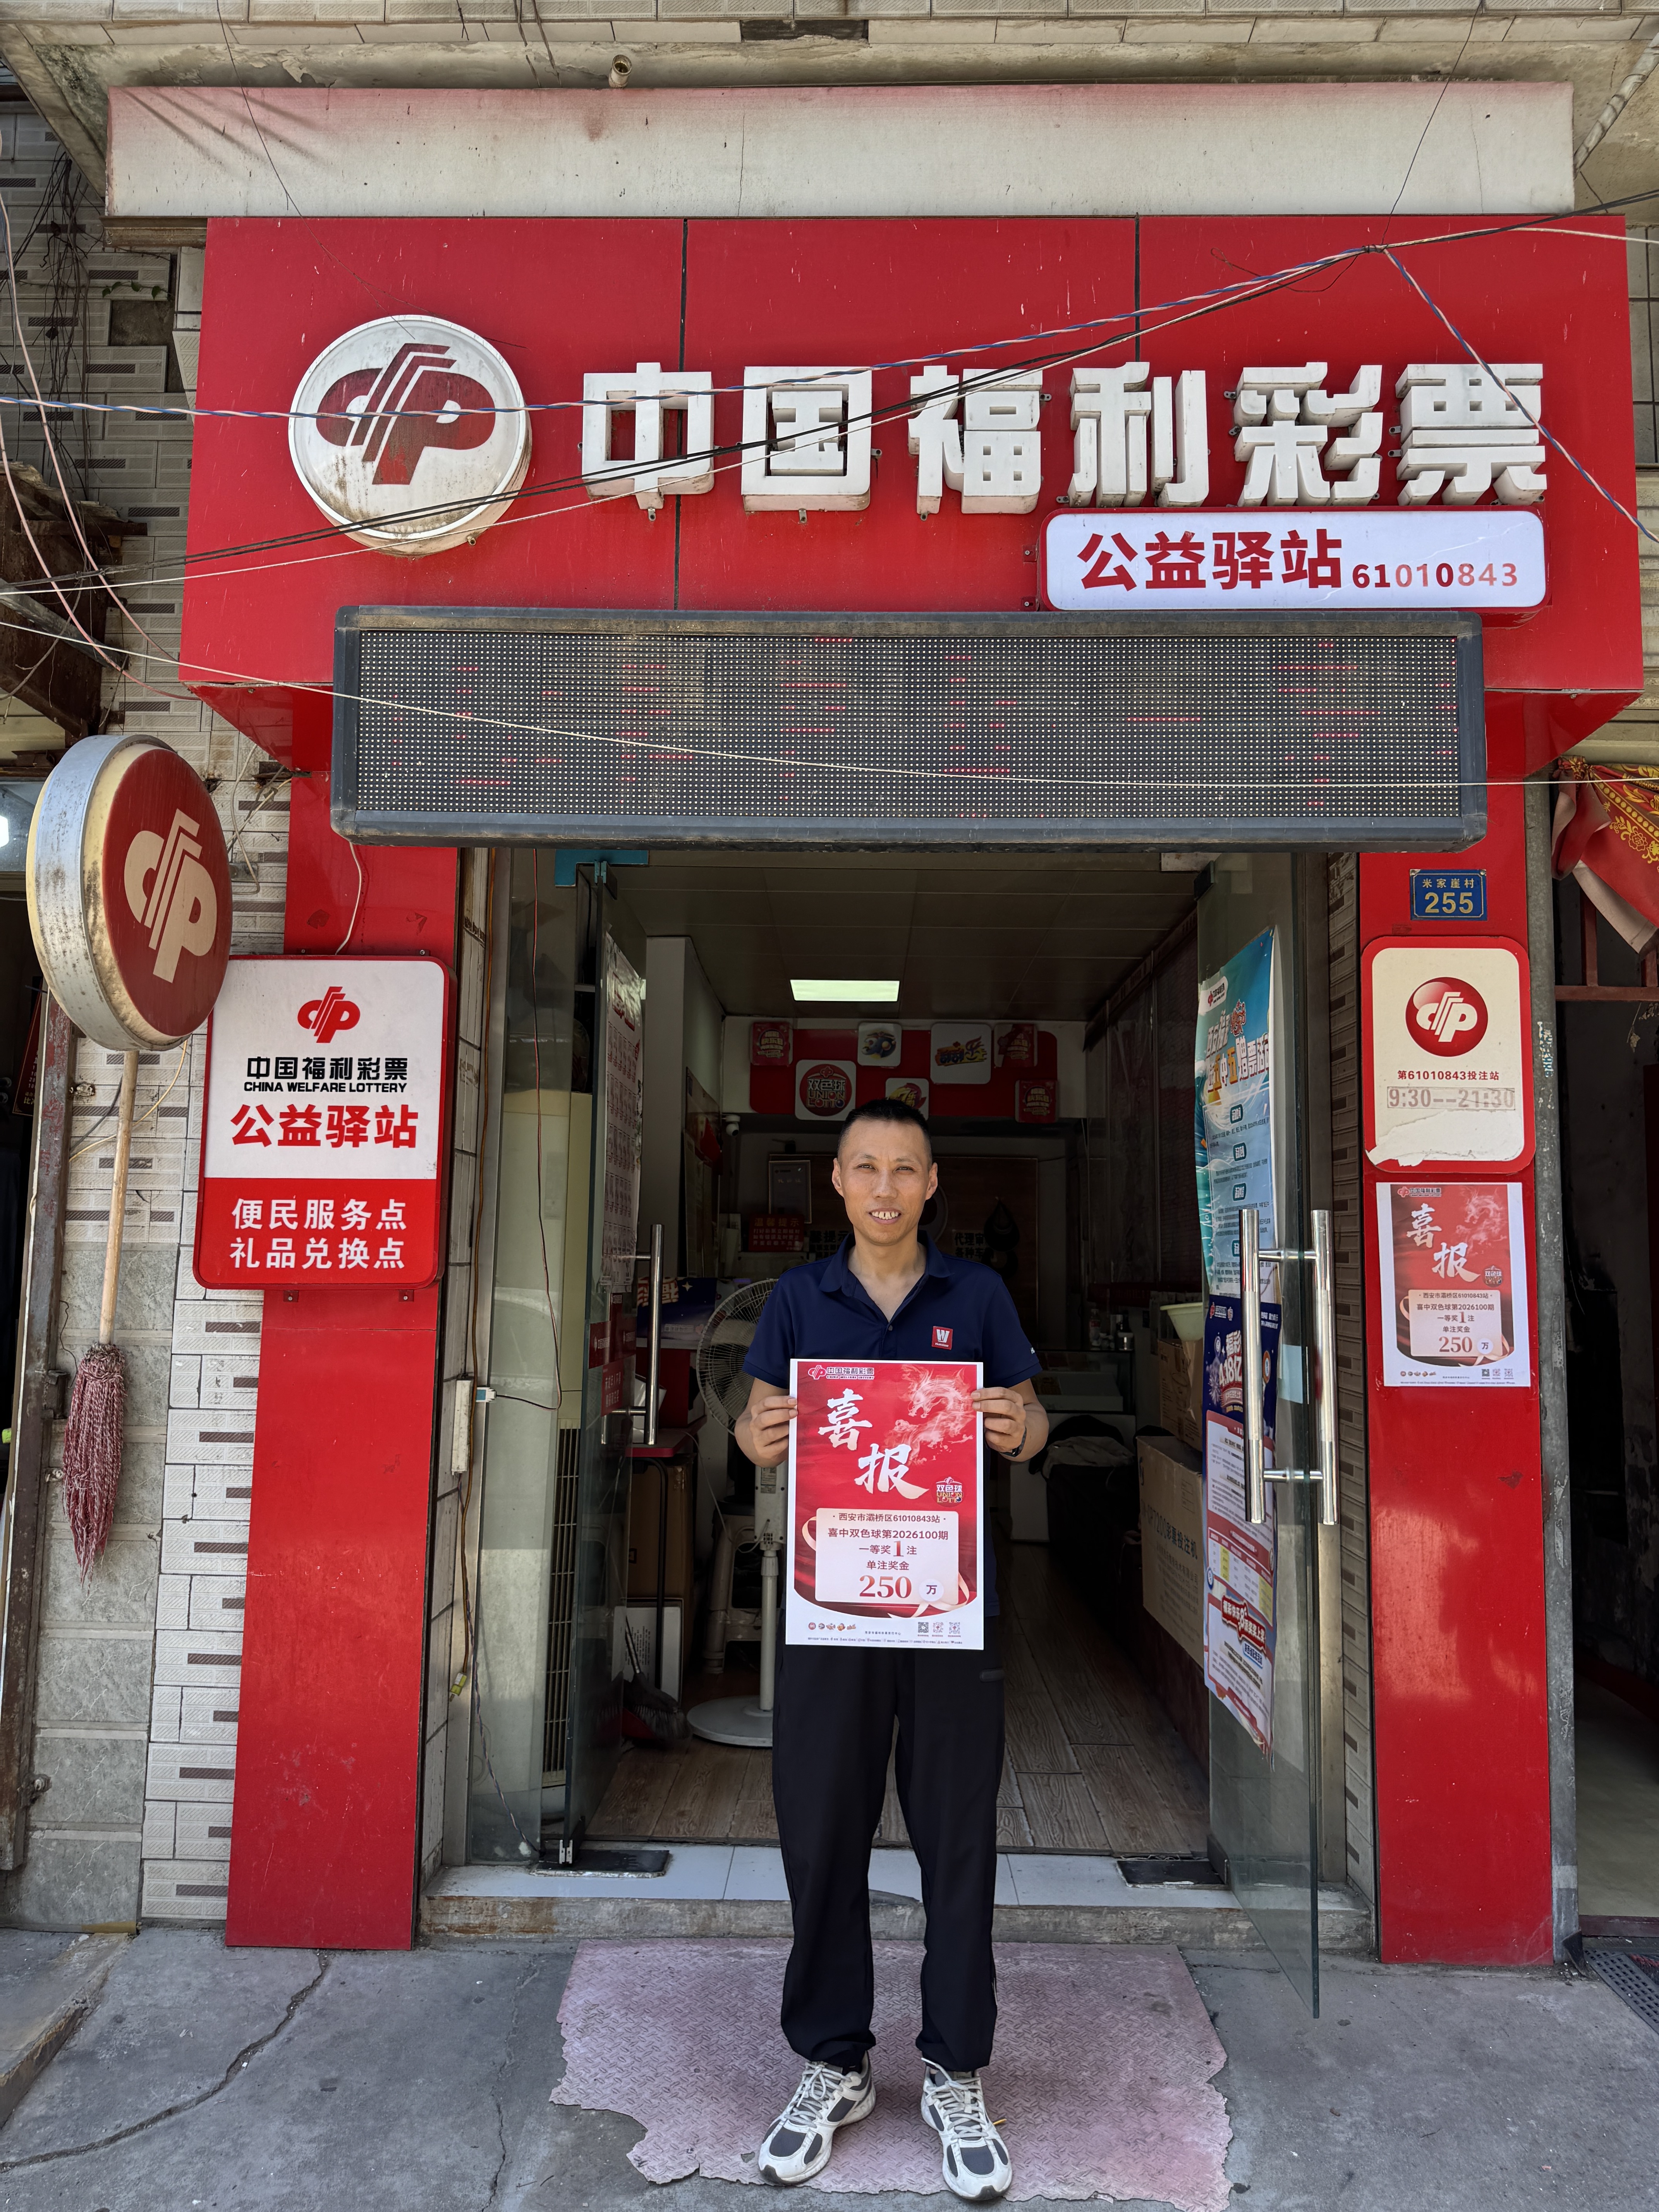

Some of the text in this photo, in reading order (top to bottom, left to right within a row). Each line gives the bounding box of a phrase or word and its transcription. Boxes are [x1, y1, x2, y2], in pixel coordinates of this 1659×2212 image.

[583, 362, 1547, 513] 中国福利彩票
[1078, 529, 1518, 591] 公益驿站 61010843
[1422, 878, 1474, 888] 米家崖村
[1425, 892, 1474, 914] 255
[247, 1056, 408, 1080] 中国福利彩票
[1397, 1070, 1499, 1081] 第61010843投注站
[244, 1082, 407, 1093] CHINA WELFARE LOTTERY
[808, 1079, 845, 1092] 双色球
[806, 1099, 845, 1108] LOTTO
[807, 1091, 846, 1100] UNION
[230, 1104, 418, 1148] 公益驿站
[232, 1198, 407, 1230] 便民服务点
[230, 1237, 405, 1269] 礼品兑换点
[1439, 1336, 1472, 1353] 250
[828, 1528, 948, 1540] 喜中双色球第2026100期
[859, 1540, 917, 1557] 一等奖1注
[866, 1560, 909, 1571] 单注奖金
[859, 1575, 937, 1599] 250 万
